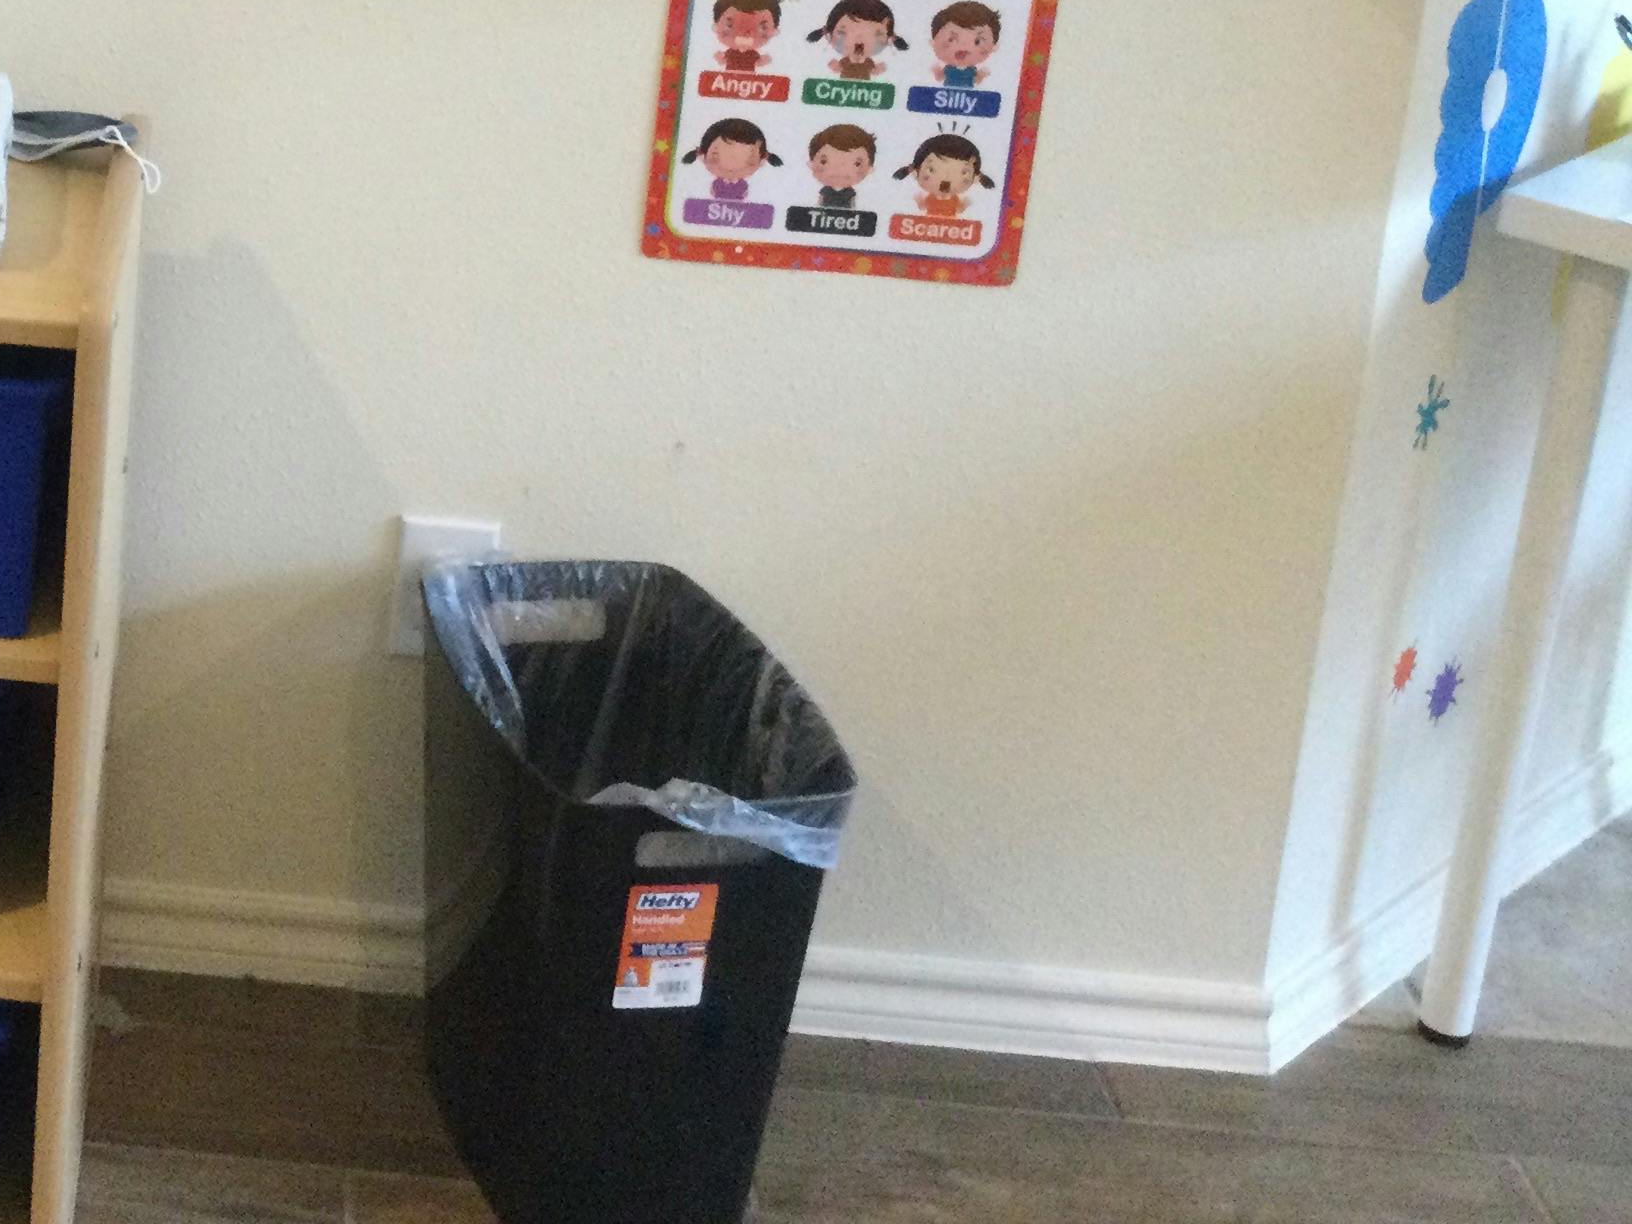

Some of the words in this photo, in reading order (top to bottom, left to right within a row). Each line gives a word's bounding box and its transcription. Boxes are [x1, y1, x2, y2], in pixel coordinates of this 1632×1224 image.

[711, 75, 774, 98] Angry
[815, 81, 882, 107] Crying
[933, 89, 976, 113] Silly
[708, 203, 744, 225] Shy
[807, 209, 860, 231] Tired
[900, 218, 973, 241] Scared
[640, 894, 695, 909] Hefty
